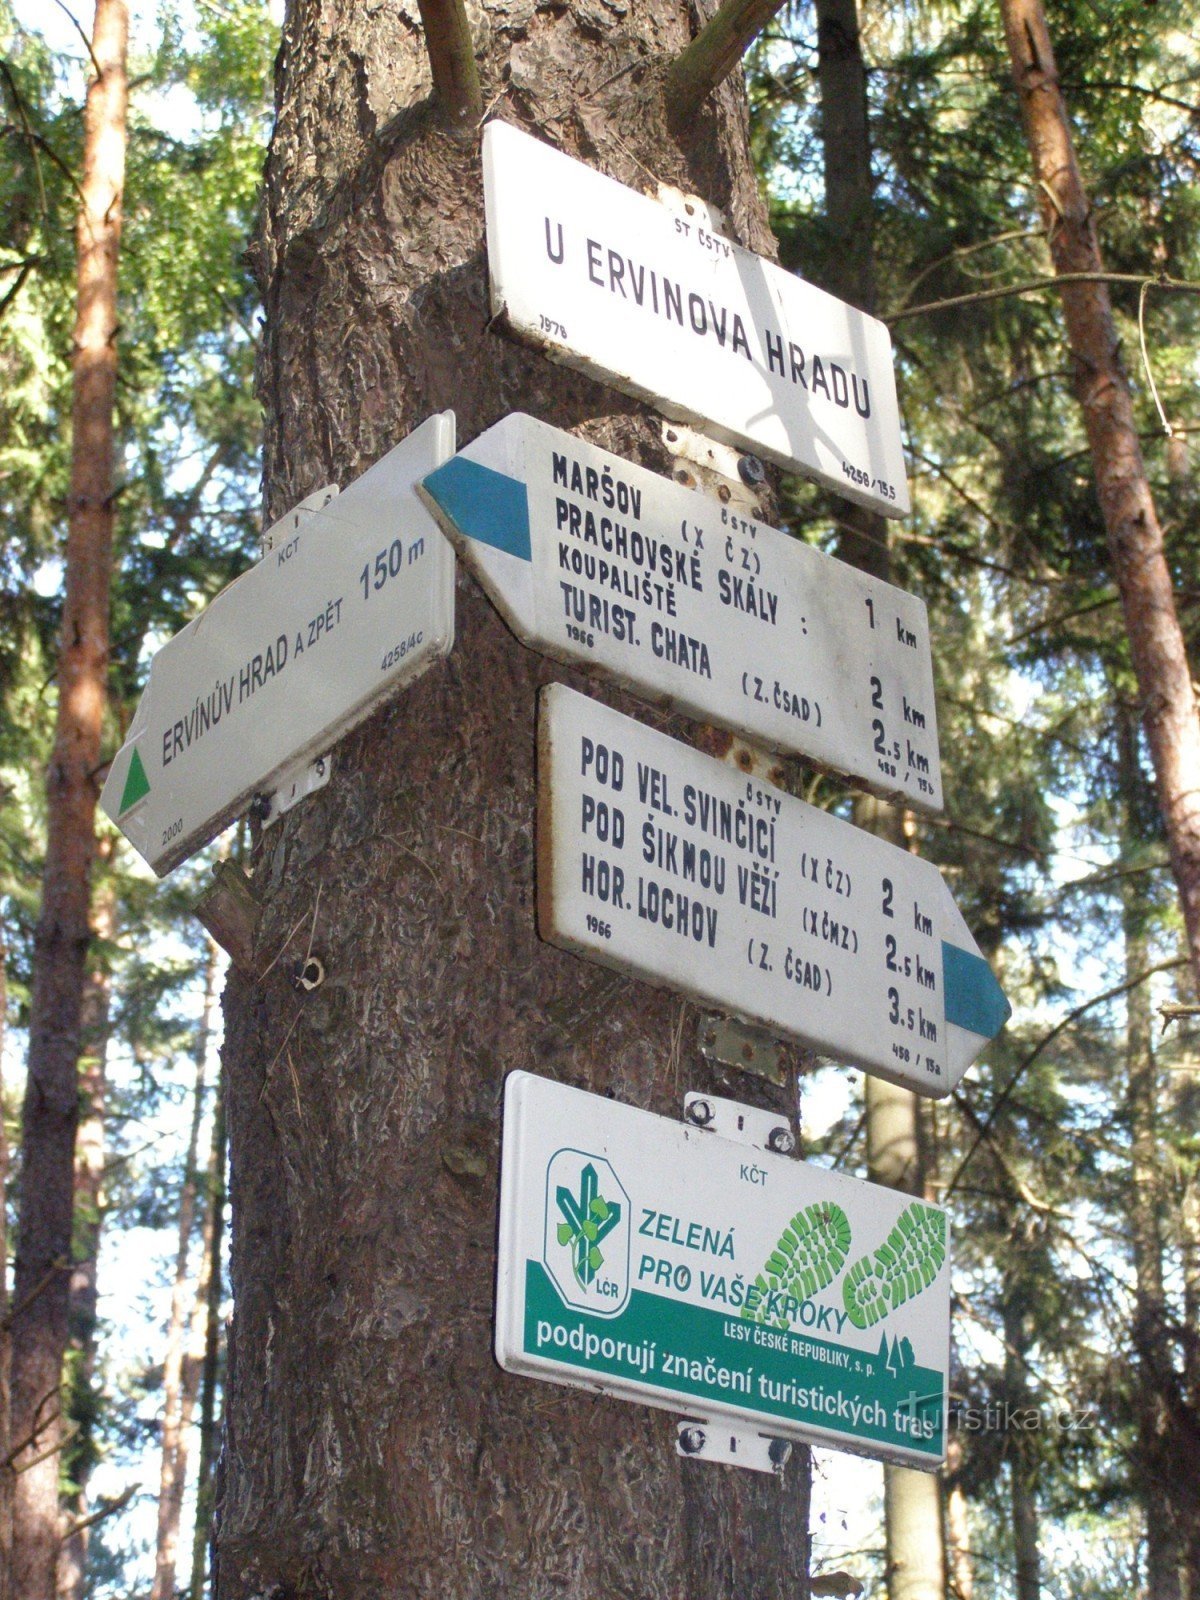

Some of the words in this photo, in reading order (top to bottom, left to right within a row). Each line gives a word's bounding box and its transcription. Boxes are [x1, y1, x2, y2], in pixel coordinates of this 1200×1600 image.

[540, 314, 567, 339] 1978
[545, 217, 564, 265] U
[587, 238, 752, 361] ERVINOVA
[765, 330, 871, 419] HRADU
[552, 452, 642, 520] MARŠOV
[865, 598, 875, 629] 1
[896, 617, 917, 649] km
[556, 497, 703, 592] PRACHOVSKÉ
[718, 569, 778, 625] SKÁLY
[163, 676, 234, 767] ERVÍNŮV
[239, 634, 288, 703] HRAD
[294, 632, 304, 660] A
[307, 598, 343, 648] ZPĚT
[360, 539, 401, 600] 150
[408, 537, 425, 565] m
[559, 542, 677, 617] KOUPALIŠTĚ
[870, 676, 883, 711] 2
[903, 696, 926, 729] km
[560, 581, 640, 645] TURIST.
[651, 622, 712, 679] CHATA
[872, 719, 901, 761] 2.5
[907, 739, 930, 775] km
[566, 624, 594, 648] 1966
[162, 818, 184, 846] 2000
[581, 736, 624, 792] POD
[882, 878, 894, 918] 2
[914, 902, 933, 936] km
[582, 794, 625, 850] POD
[642, 814, 726, 895] ŠIKMOU
[737, 862, 780, 919] VĚŽÍ
[886, 934, 911, 977] 2.5
[917, 954, 935, 990] km
[586, 914, 612, 940] 1966
[888, 987, 915, 1030] 3.5
[919, 1007, 937, 1042] km
[740, 1163, 769, 1186] KČT
[639, 1208, 736, 1260] ZELENÁ
[639, 1255, 692, 1291] PRO
[700, 1271, 760, 1311] VAŠE
[766, 1290, 849, 1335] KROKY
[537, 1320, 655, 1371] podporují
[663, 1351, 752, 1393] značení
[758, 1373, 887, 1429] turistických
[894, 1411, 934, 1440] tras
[724, 1321, 751, 1343] LESY
[753, 1325, 788, 1352] ČESKÉ
[791, 1336, 853, 1371] REPUBLIKY,
